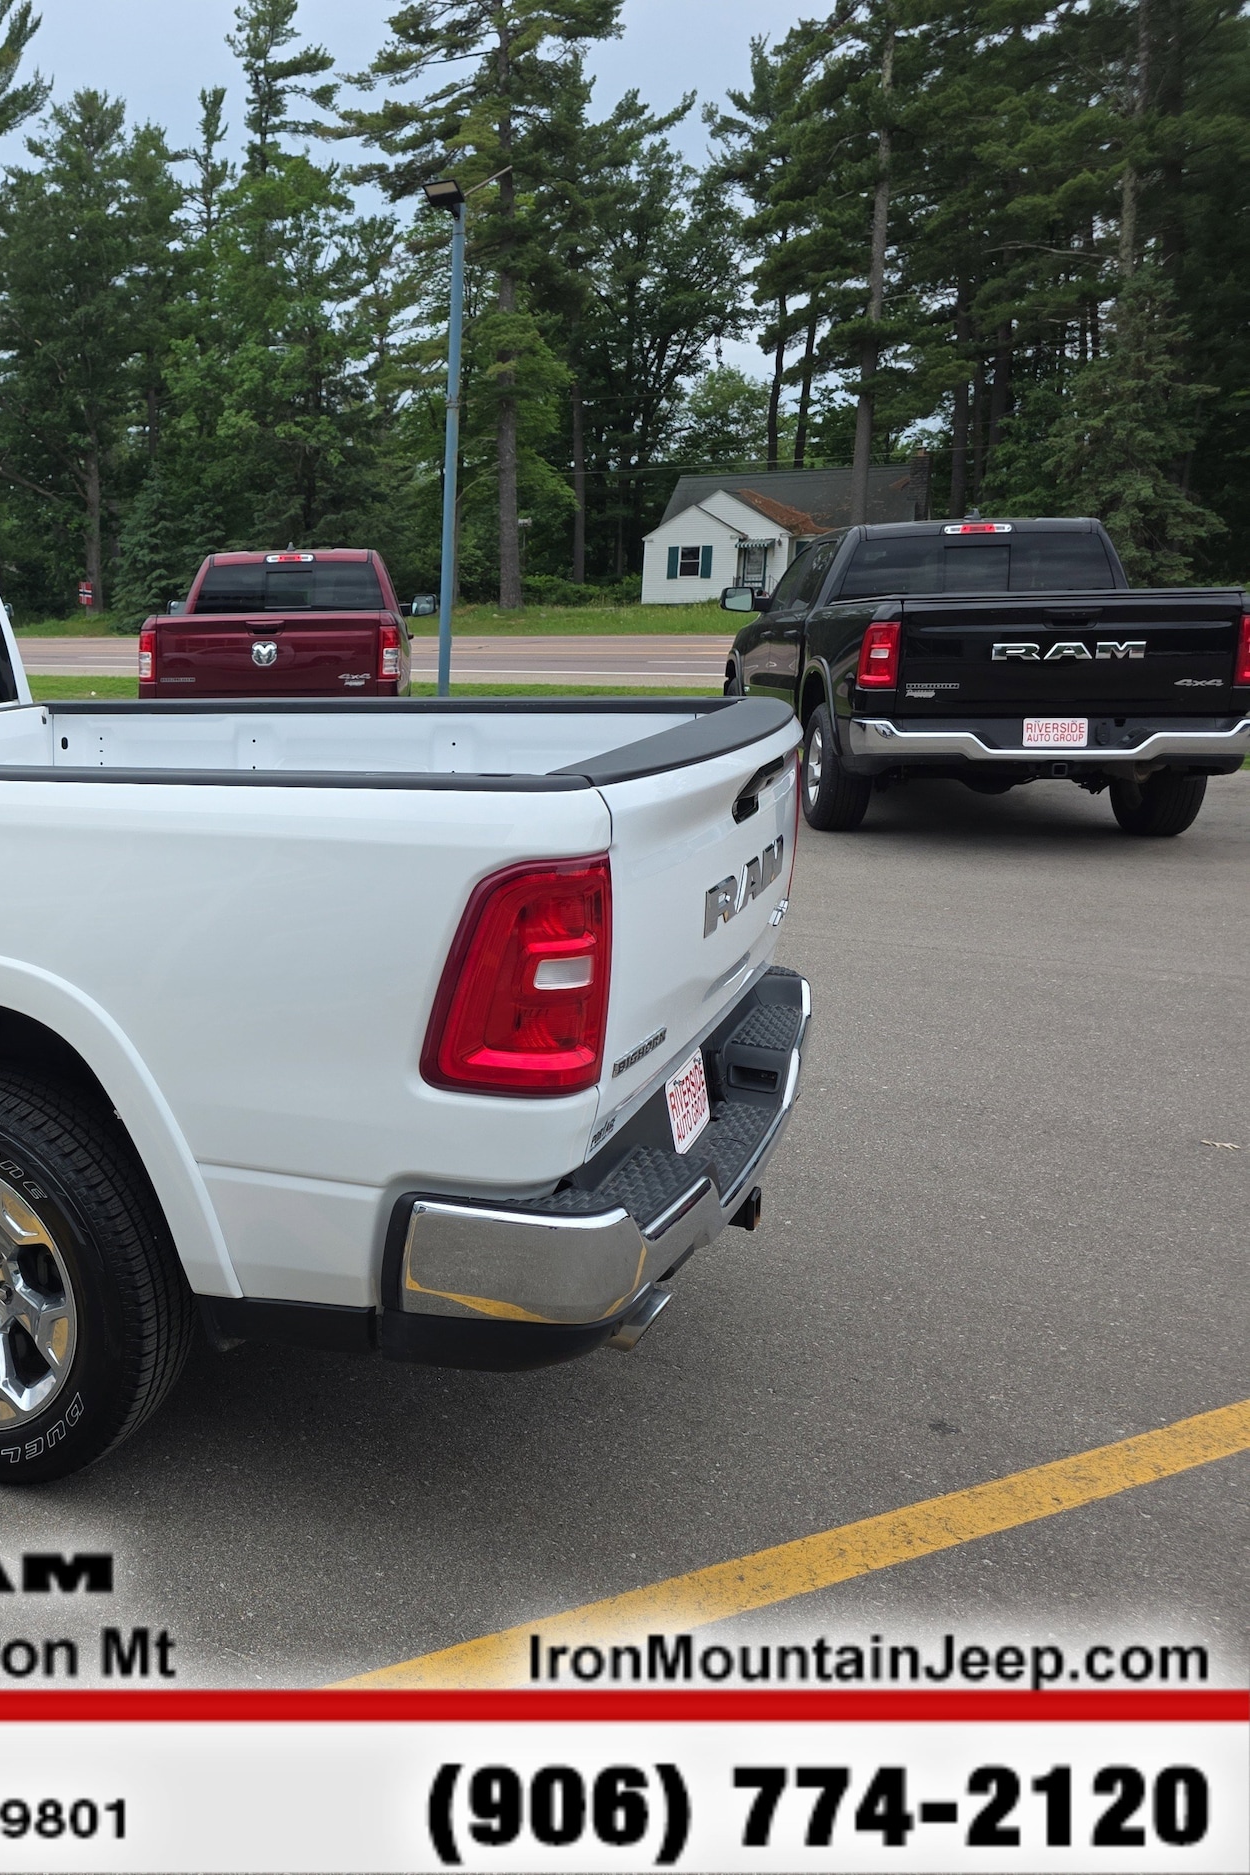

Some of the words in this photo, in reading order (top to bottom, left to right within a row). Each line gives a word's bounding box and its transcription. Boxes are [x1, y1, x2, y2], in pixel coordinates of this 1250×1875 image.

[991, 641, 1147, 661] RAM
[1174, 679, 1224, 687] 4x4
[1026, 722, 1085, 733] RIVERSIDE
[1027, 733, 1051, 742] AUTO
[1053, 733, 1084, 742] GROUP
[668, 1062, 705, 1122] RIVERSIDE
[676, 1108, 693, 1144] AUTO
